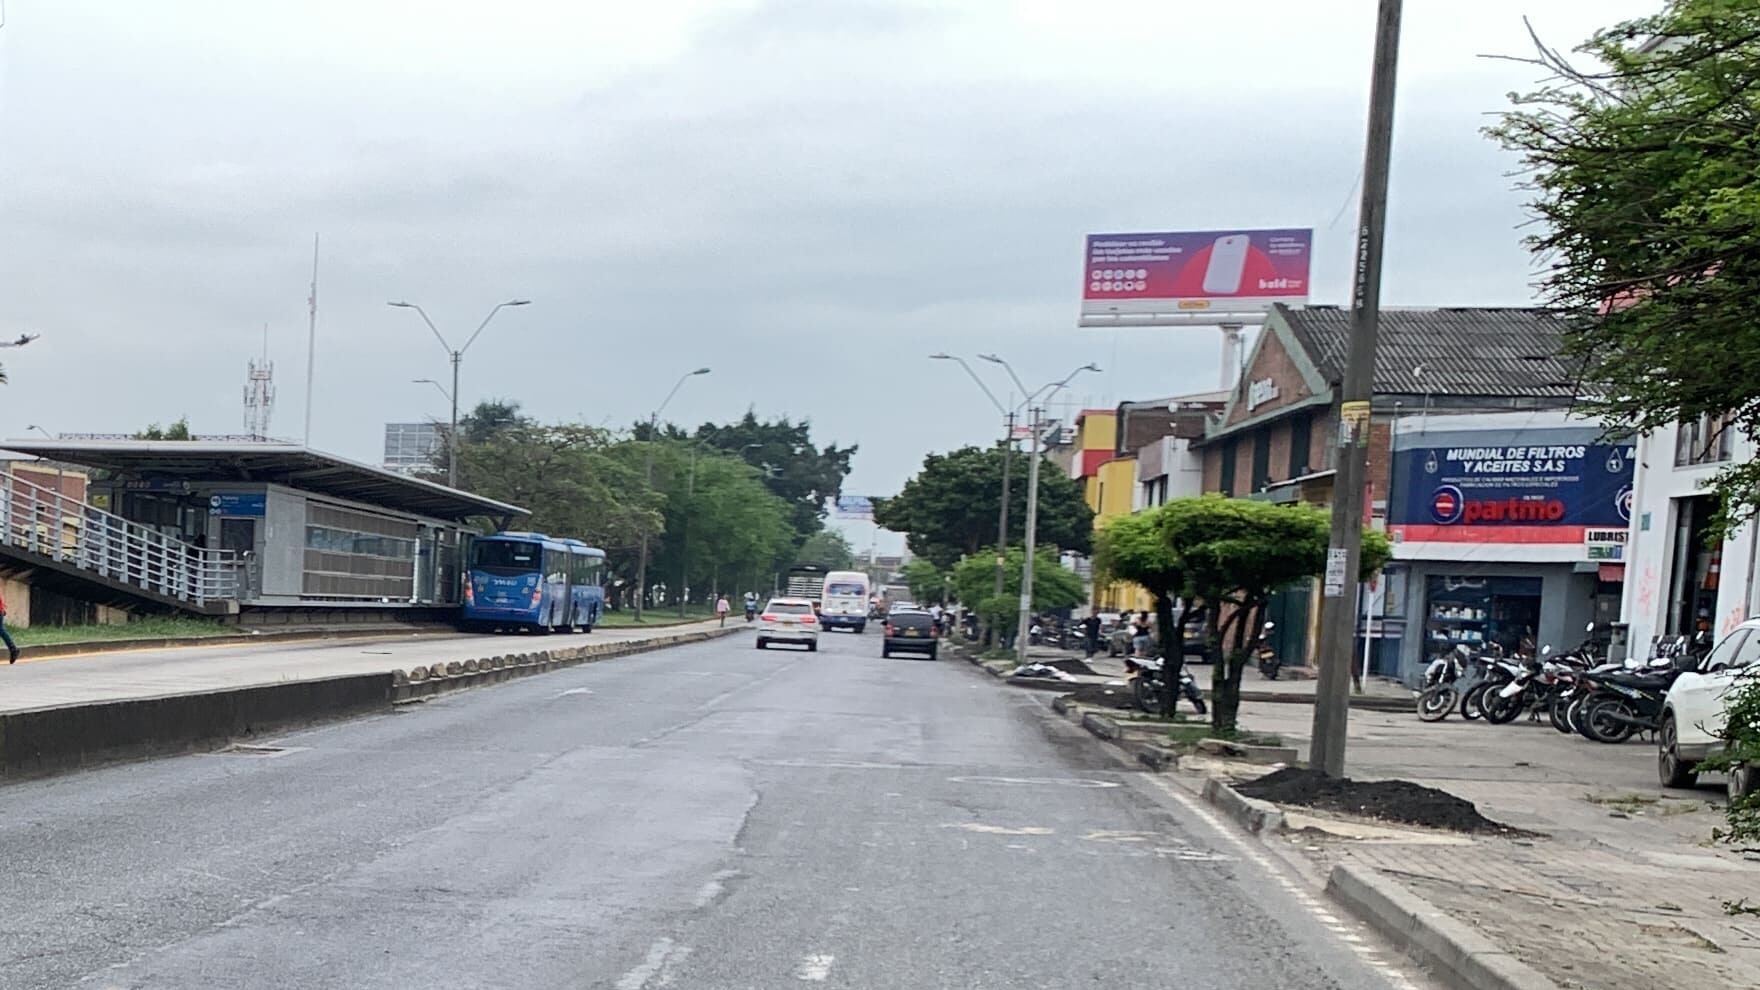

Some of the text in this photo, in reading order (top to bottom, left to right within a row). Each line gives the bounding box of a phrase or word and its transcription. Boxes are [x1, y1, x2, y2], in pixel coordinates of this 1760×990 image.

[1446, 446, 1586, 461] MUNDIAL DE FILTROS
[1463, 460, 1473, 473] Y
[1473, 460, 1531, 472] ACEITES
[1463, 497, 1564, 523] partmo
